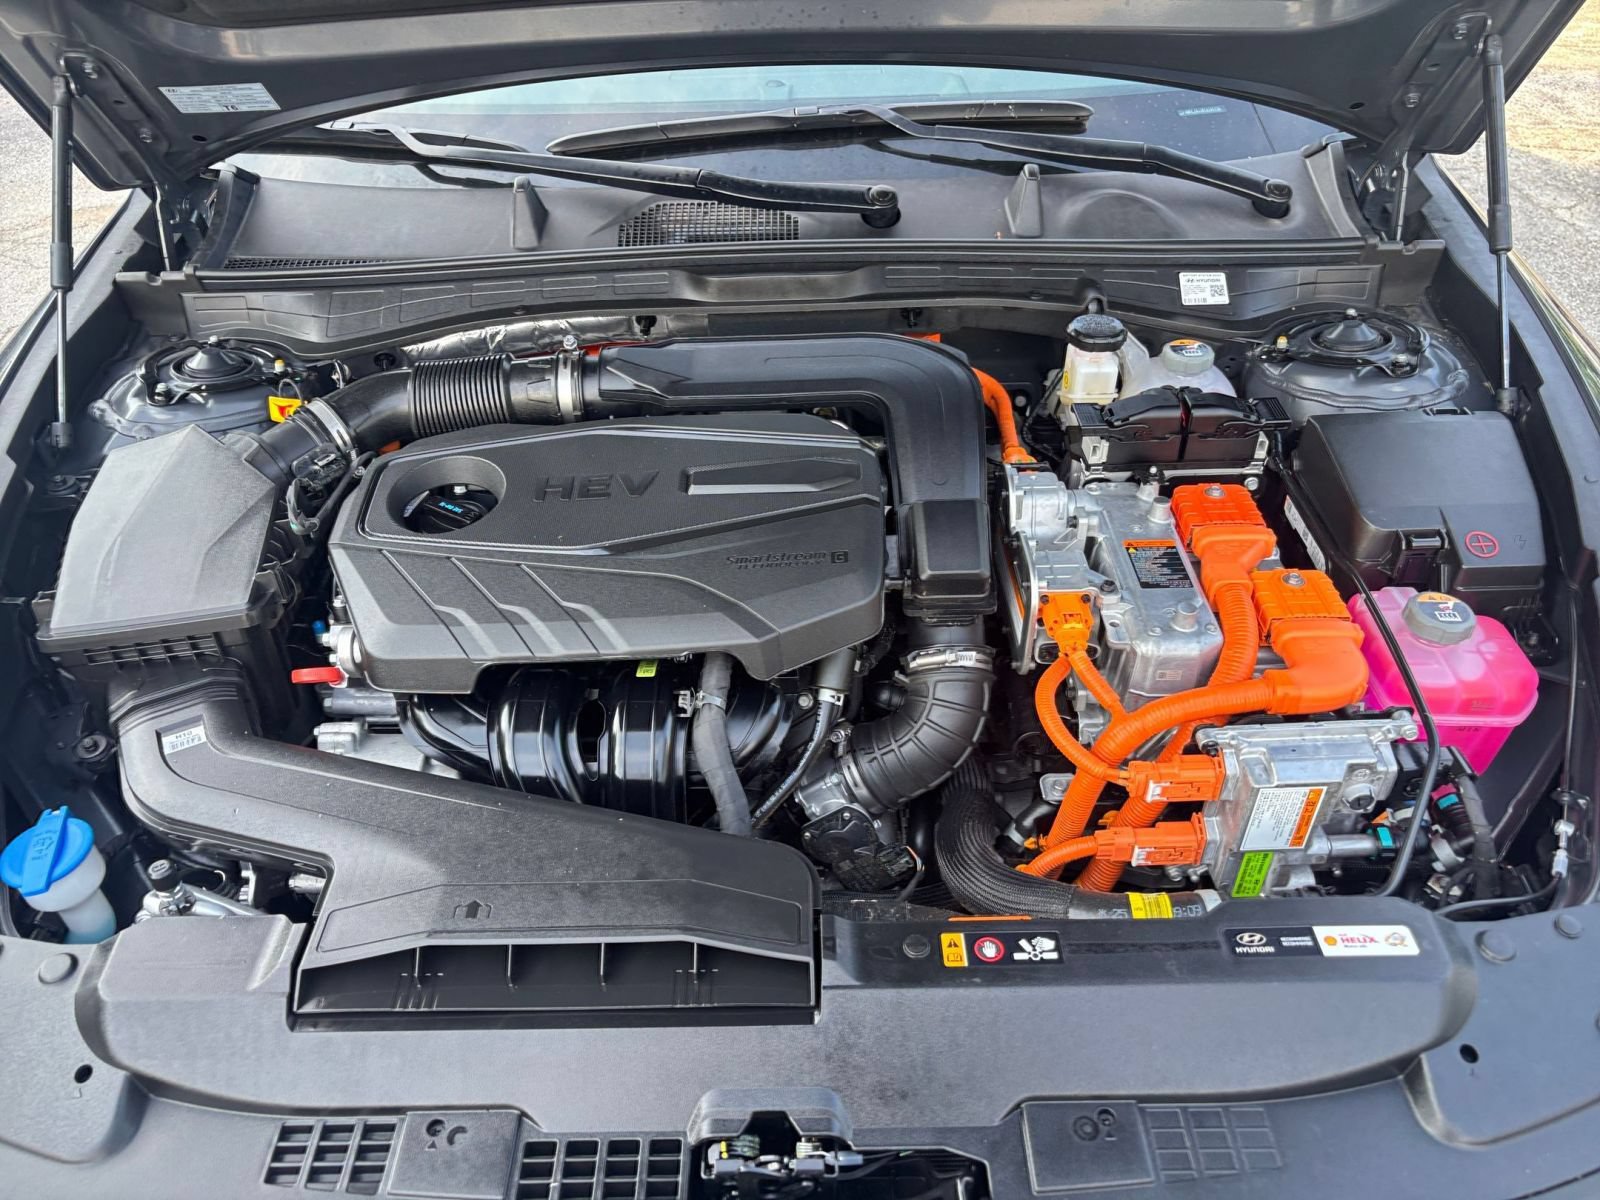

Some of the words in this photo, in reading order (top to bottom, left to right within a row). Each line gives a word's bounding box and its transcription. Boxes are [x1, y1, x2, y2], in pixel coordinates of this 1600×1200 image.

[533, 469, 660, 502] HEV
[726, 551, 826, 564] Smartstream
[1340, 936, 1376, 944] HELIX
